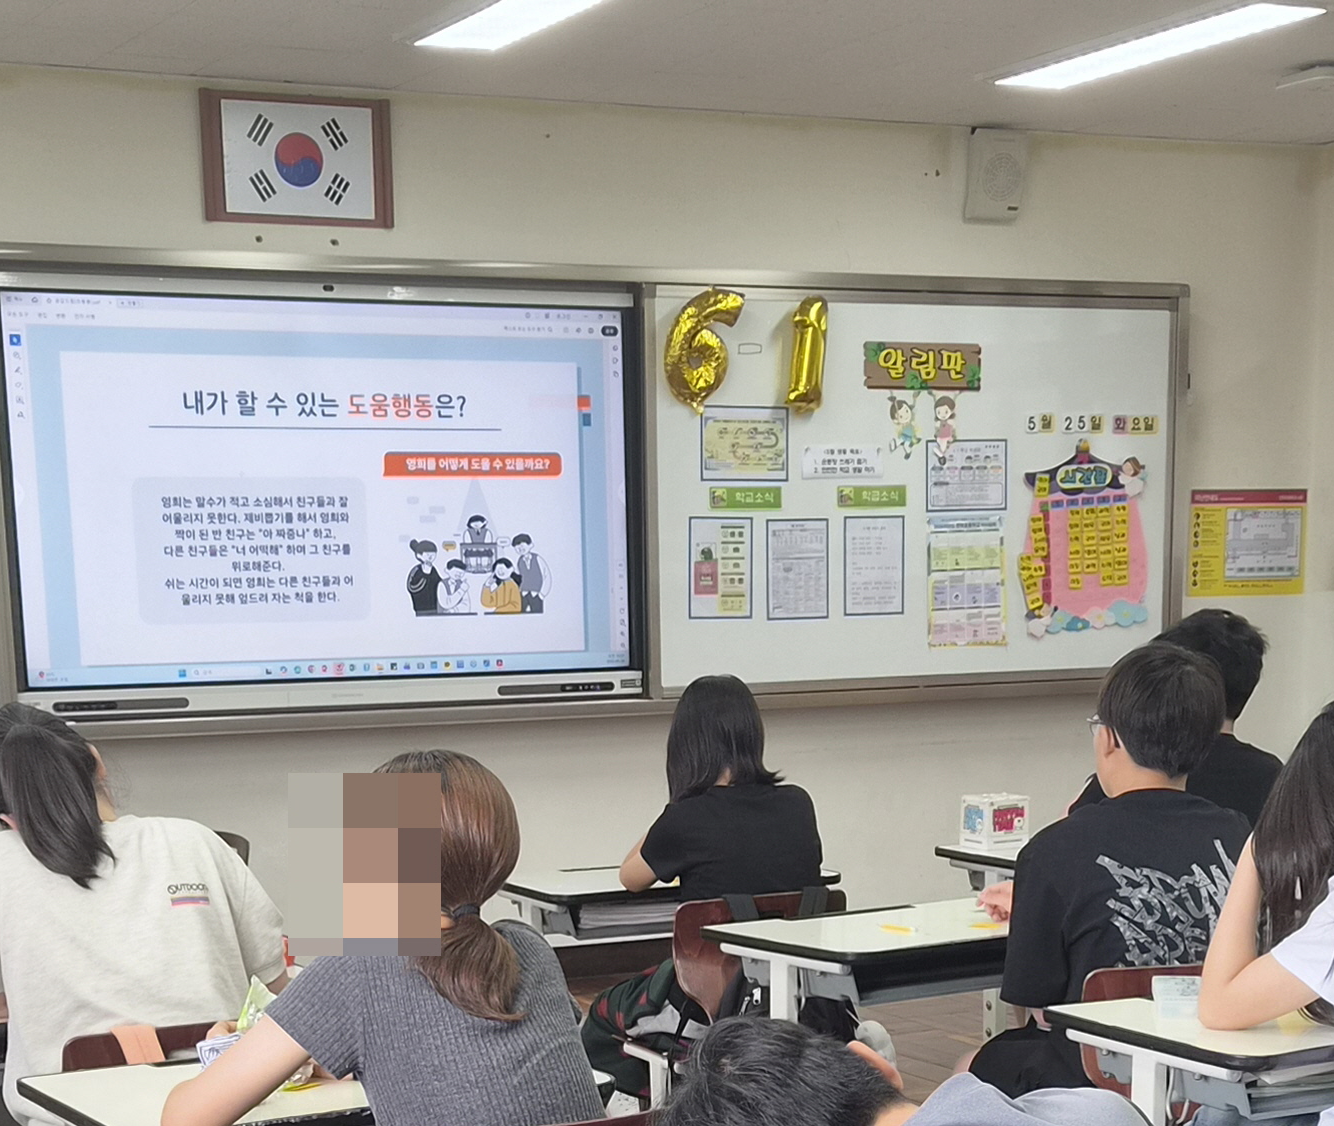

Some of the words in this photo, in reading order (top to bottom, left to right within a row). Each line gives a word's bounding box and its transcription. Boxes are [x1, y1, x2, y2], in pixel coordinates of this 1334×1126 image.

[878, 345, 967, 381] 알림판
[184, 391, 228, 415] 내가
[236, 391, 257, 416] 할
[266, 392, 287, 416] 수
[296, 391, 339, 417] 있는
[348, 393, 466, 418] 도움행동은?
[1028, 414, 1052, 430] 5월
[1064, 415, 1101, 430] 25일
[1115, 416, 1154, 431] 화요일
[406, 457, 435, 471] 영희를
[471, 458, 490, 471] 도울
[493, 458, 503, 471] 수
[506, 458, 550, 471] 있을까요?
[736, 492, 774, 503] 학교소식
[862, 490, 898, 501] 학급소식
[162, 496, 192, 508] 영희는
[196, 496, 226, 508] 말수가
[230, 496, 249, 507] 적고
[253, 496, 293, 507] 소심해서
[296, 496, 335, 507] 친구들과
[339, 496, 348, 507] 잘
[162, 512, 203, 524] 어울리지
[207, 512, 240, 524] 못한다.
[298, 512, 317, 523] 해서
[320, 512, 349, 523] 영희와
[199, 529, 209, 540] 된
[212, 529, 221, 540] 반
[226, 528, 255, 539] 친구는
[164, 545, 184, 556] 다른
[188, 545, 228, 556] 친구들은
[286, 544, 306, 555] 하며
[310, 545, 319, 554] 그
[323, 544, 350, 555] 친구를
[232, 561, 285, 572] 위로해준다.
[165, 578, 185, 589] 쉬는
[189, 578, 219, 589] 시간이
[223, 578, 242, 588] 되면
[246, 577, 275, 588] 영희는
[279, 577, 298, 587] 다른
[302, 576, 340, 587] 친구들과
[344, 575, 353, 586] 어
[182, 594, 212, 606] 울리지
[216, 594, 235, 604] 못해
[239, 593, 268, 604] 엎드려
[271, 592, 290, 603] 자는
[295, 592, 313, 602] 척을
[317, 591, 340, 602] 한다.
